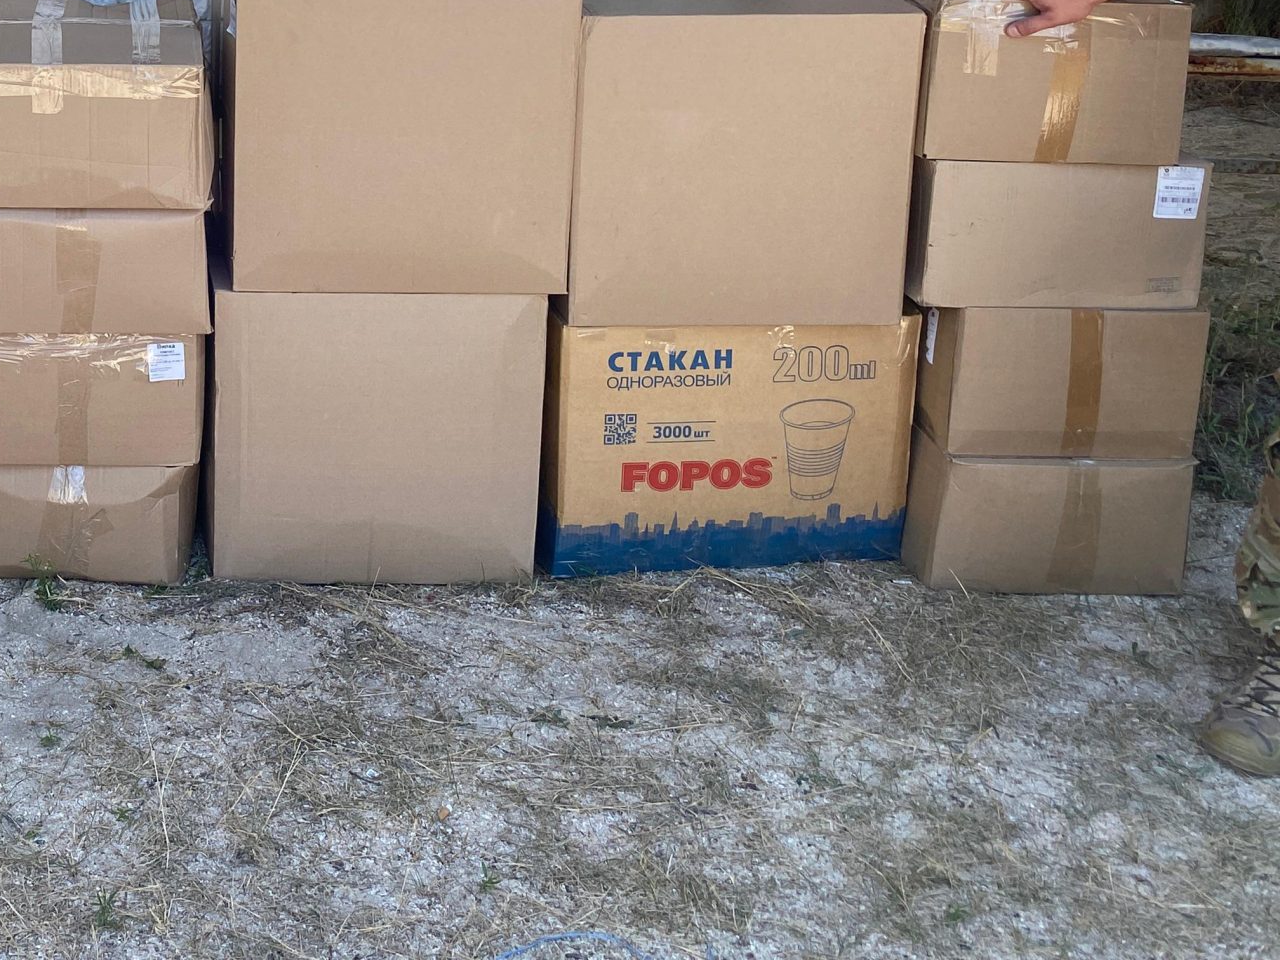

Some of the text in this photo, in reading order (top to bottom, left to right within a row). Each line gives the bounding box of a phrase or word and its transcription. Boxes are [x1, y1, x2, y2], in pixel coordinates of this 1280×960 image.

[608, 348, 733, 373] СТАКАН
[773, 344, 877, 383] 200ml
[607, 372, 731, 391] ОДНОРАЗОВЫЙ
[652, 425, 711, 439] 3000 шт
[620, 457, 773, 493] FOPOS
